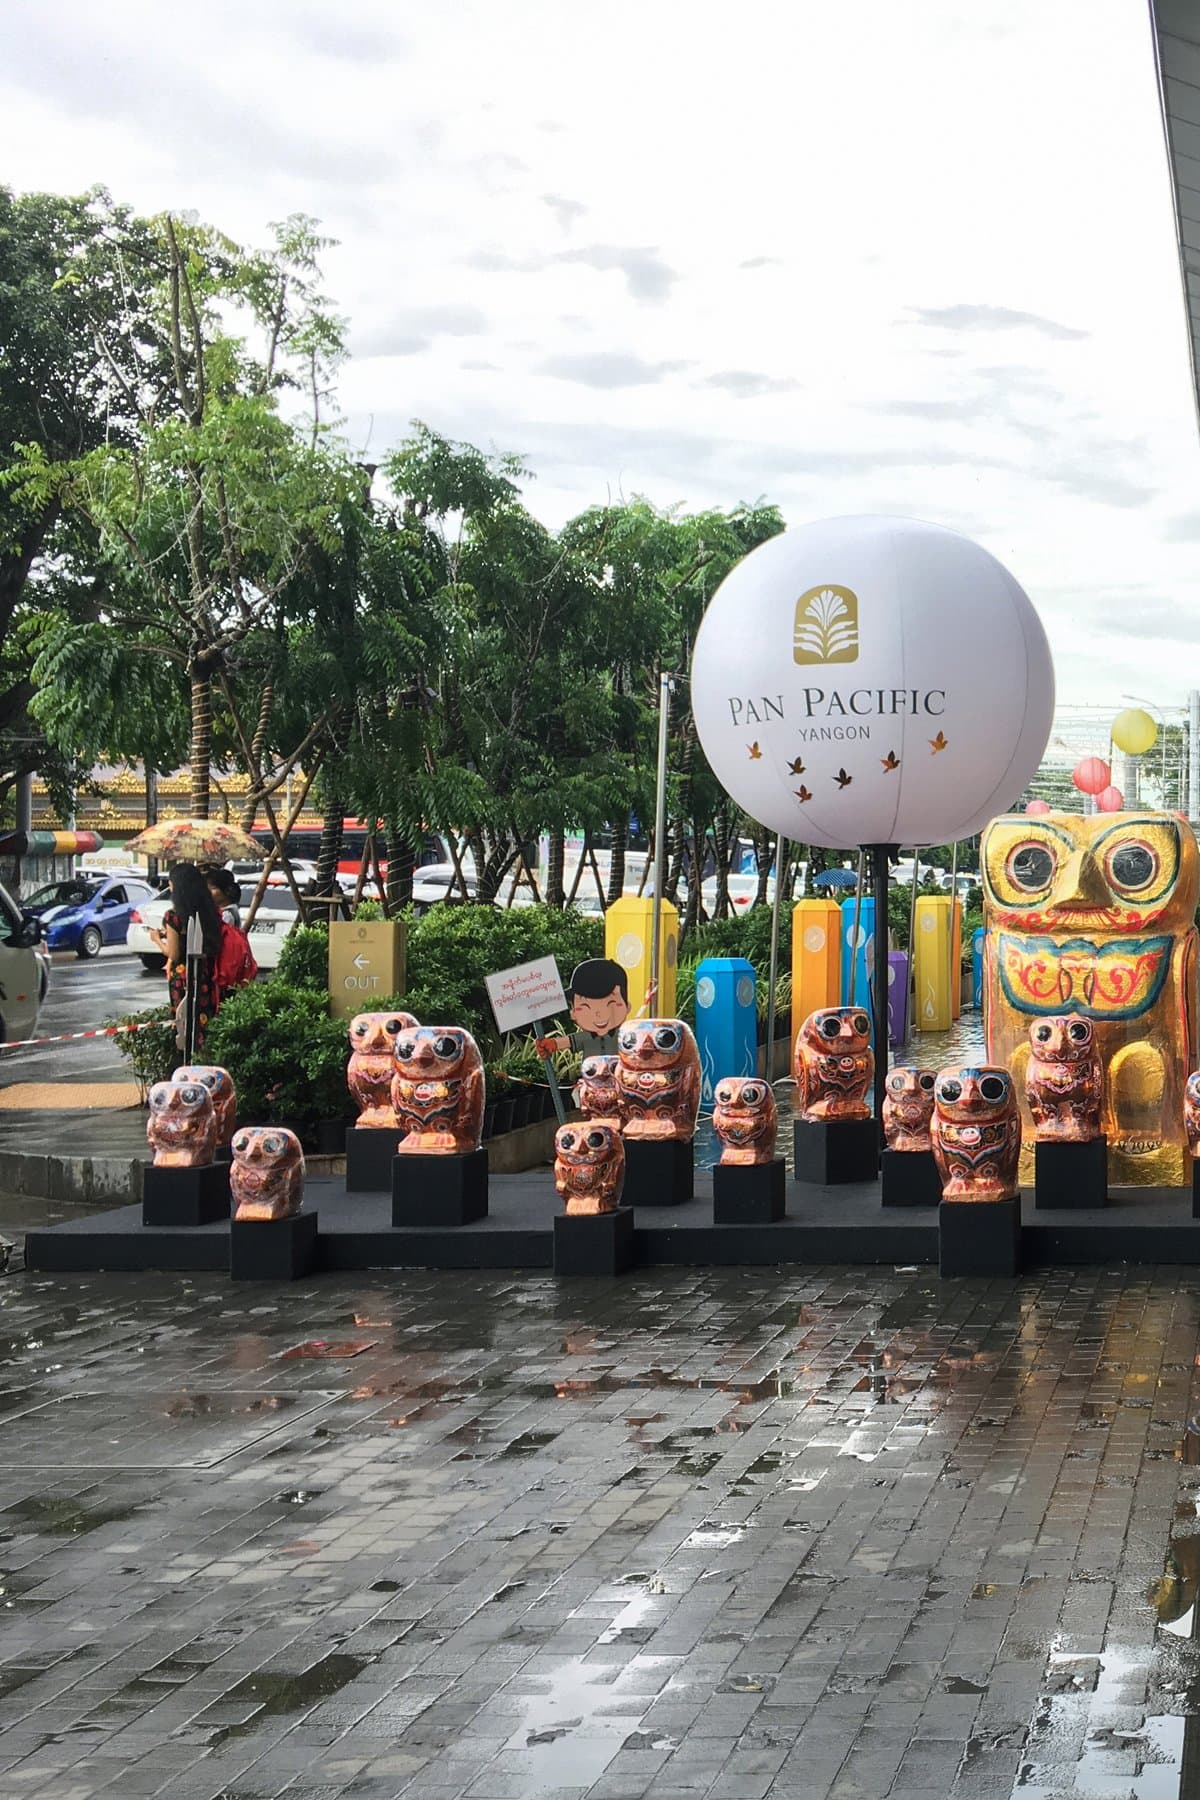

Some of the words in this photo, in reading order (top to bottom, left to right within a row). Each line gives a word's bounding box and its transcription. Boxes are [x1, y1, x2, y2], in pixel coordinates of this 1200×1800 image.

[728, 695, 785, 726] PAN
[802, 687, 946, 718] PACIFIC
[799, 725, 871, 742] YANGON
[344, 976, 380, 989] OUT
